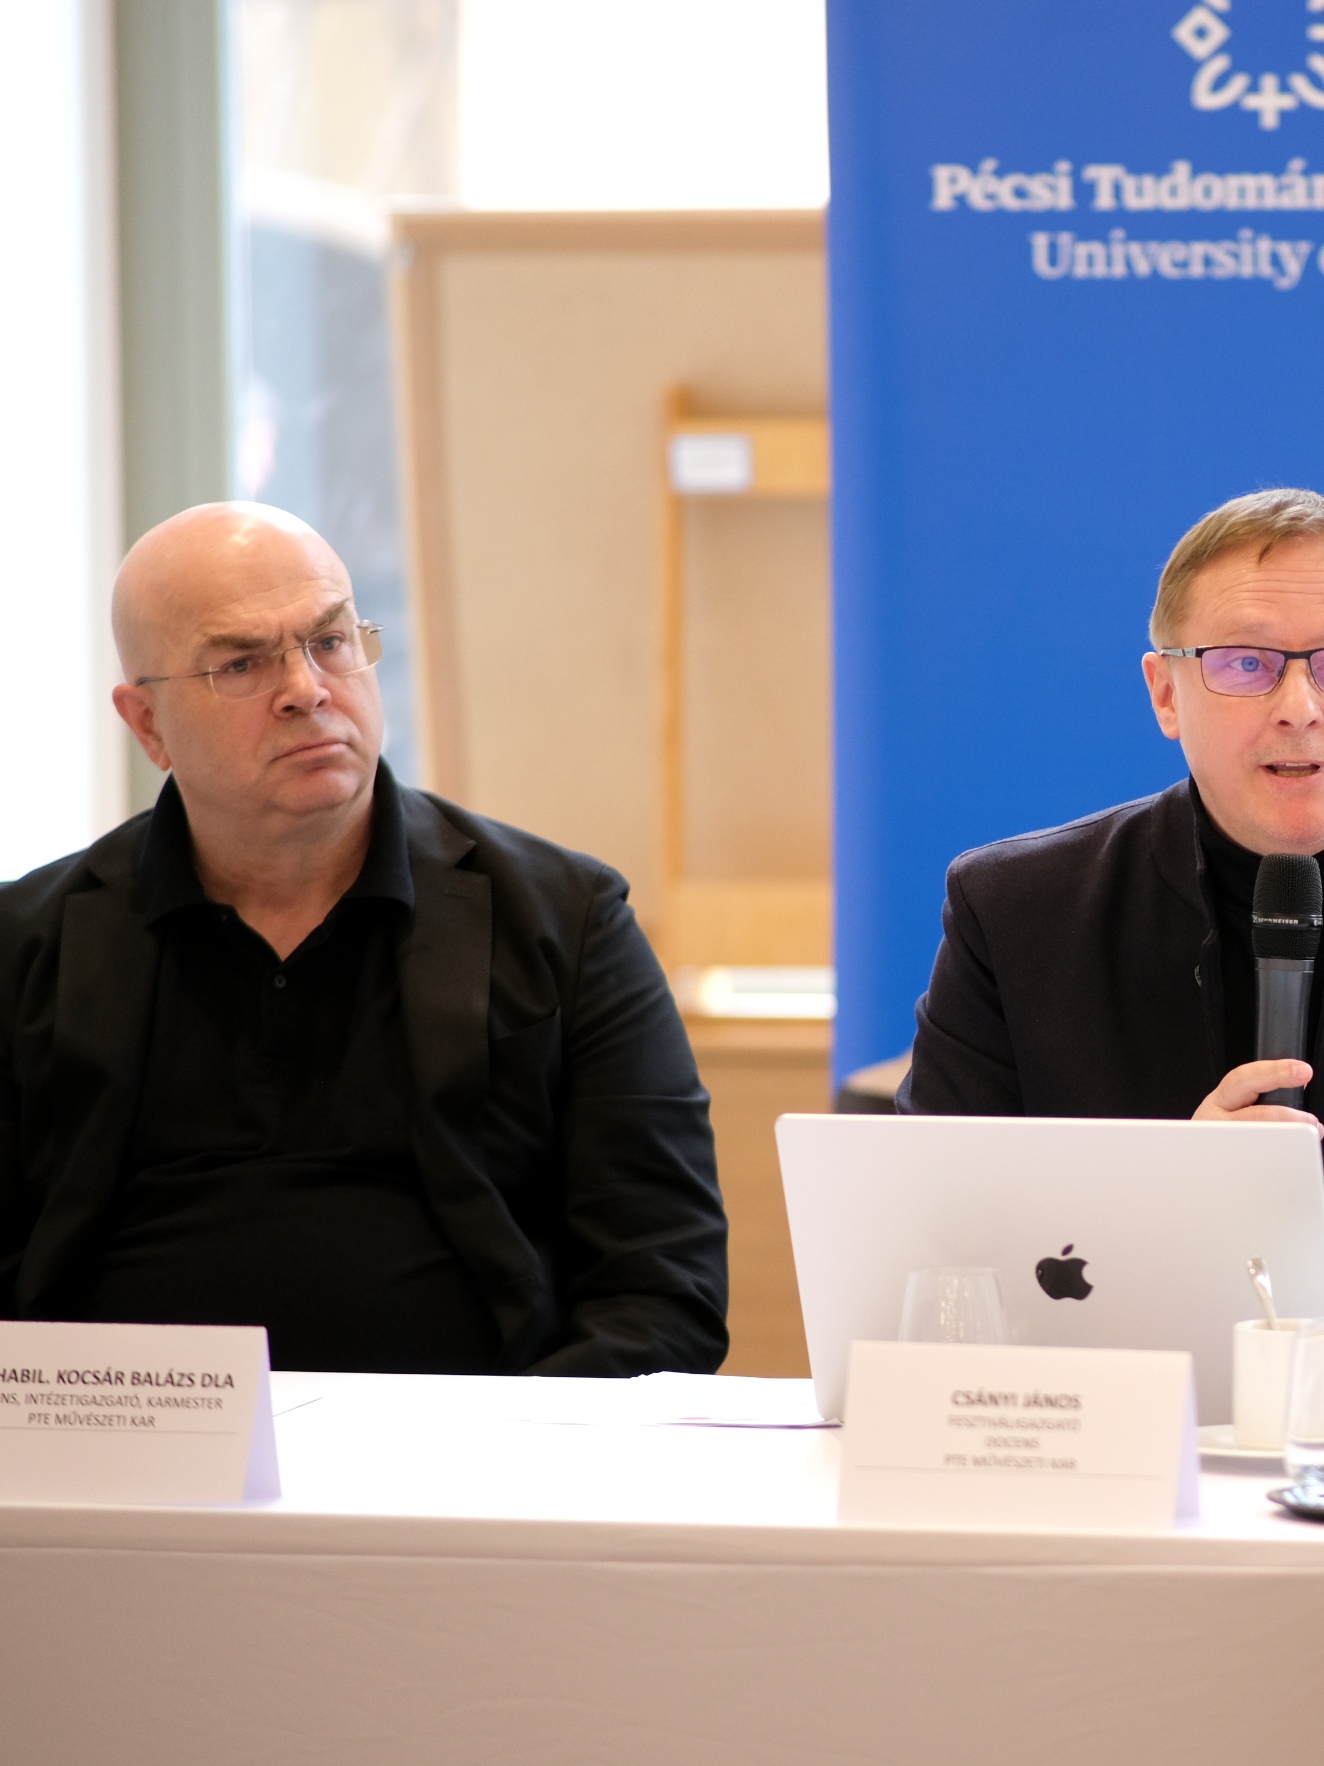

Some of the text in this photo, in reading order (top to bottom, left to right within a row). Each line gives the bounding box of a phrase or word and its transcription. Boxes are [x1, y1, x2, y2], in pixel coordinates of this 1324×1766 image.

[930, 158, 1074, 212] Pécsi
[1030, 228, 1311, 290] University
[56, 1367, 126, 1387] KOCSÁR
[131, 1368, 196, 1388] BALÁZS
[201, 1372, 235, 1389] DLA
[147, 1395, 224, 1410] KARMESTER
[950, 1387, 1082, 1410] CSÁNYI JÁNOS
[28, 1411, 156, 1427] PTE MŰVÉSZETI KAR
